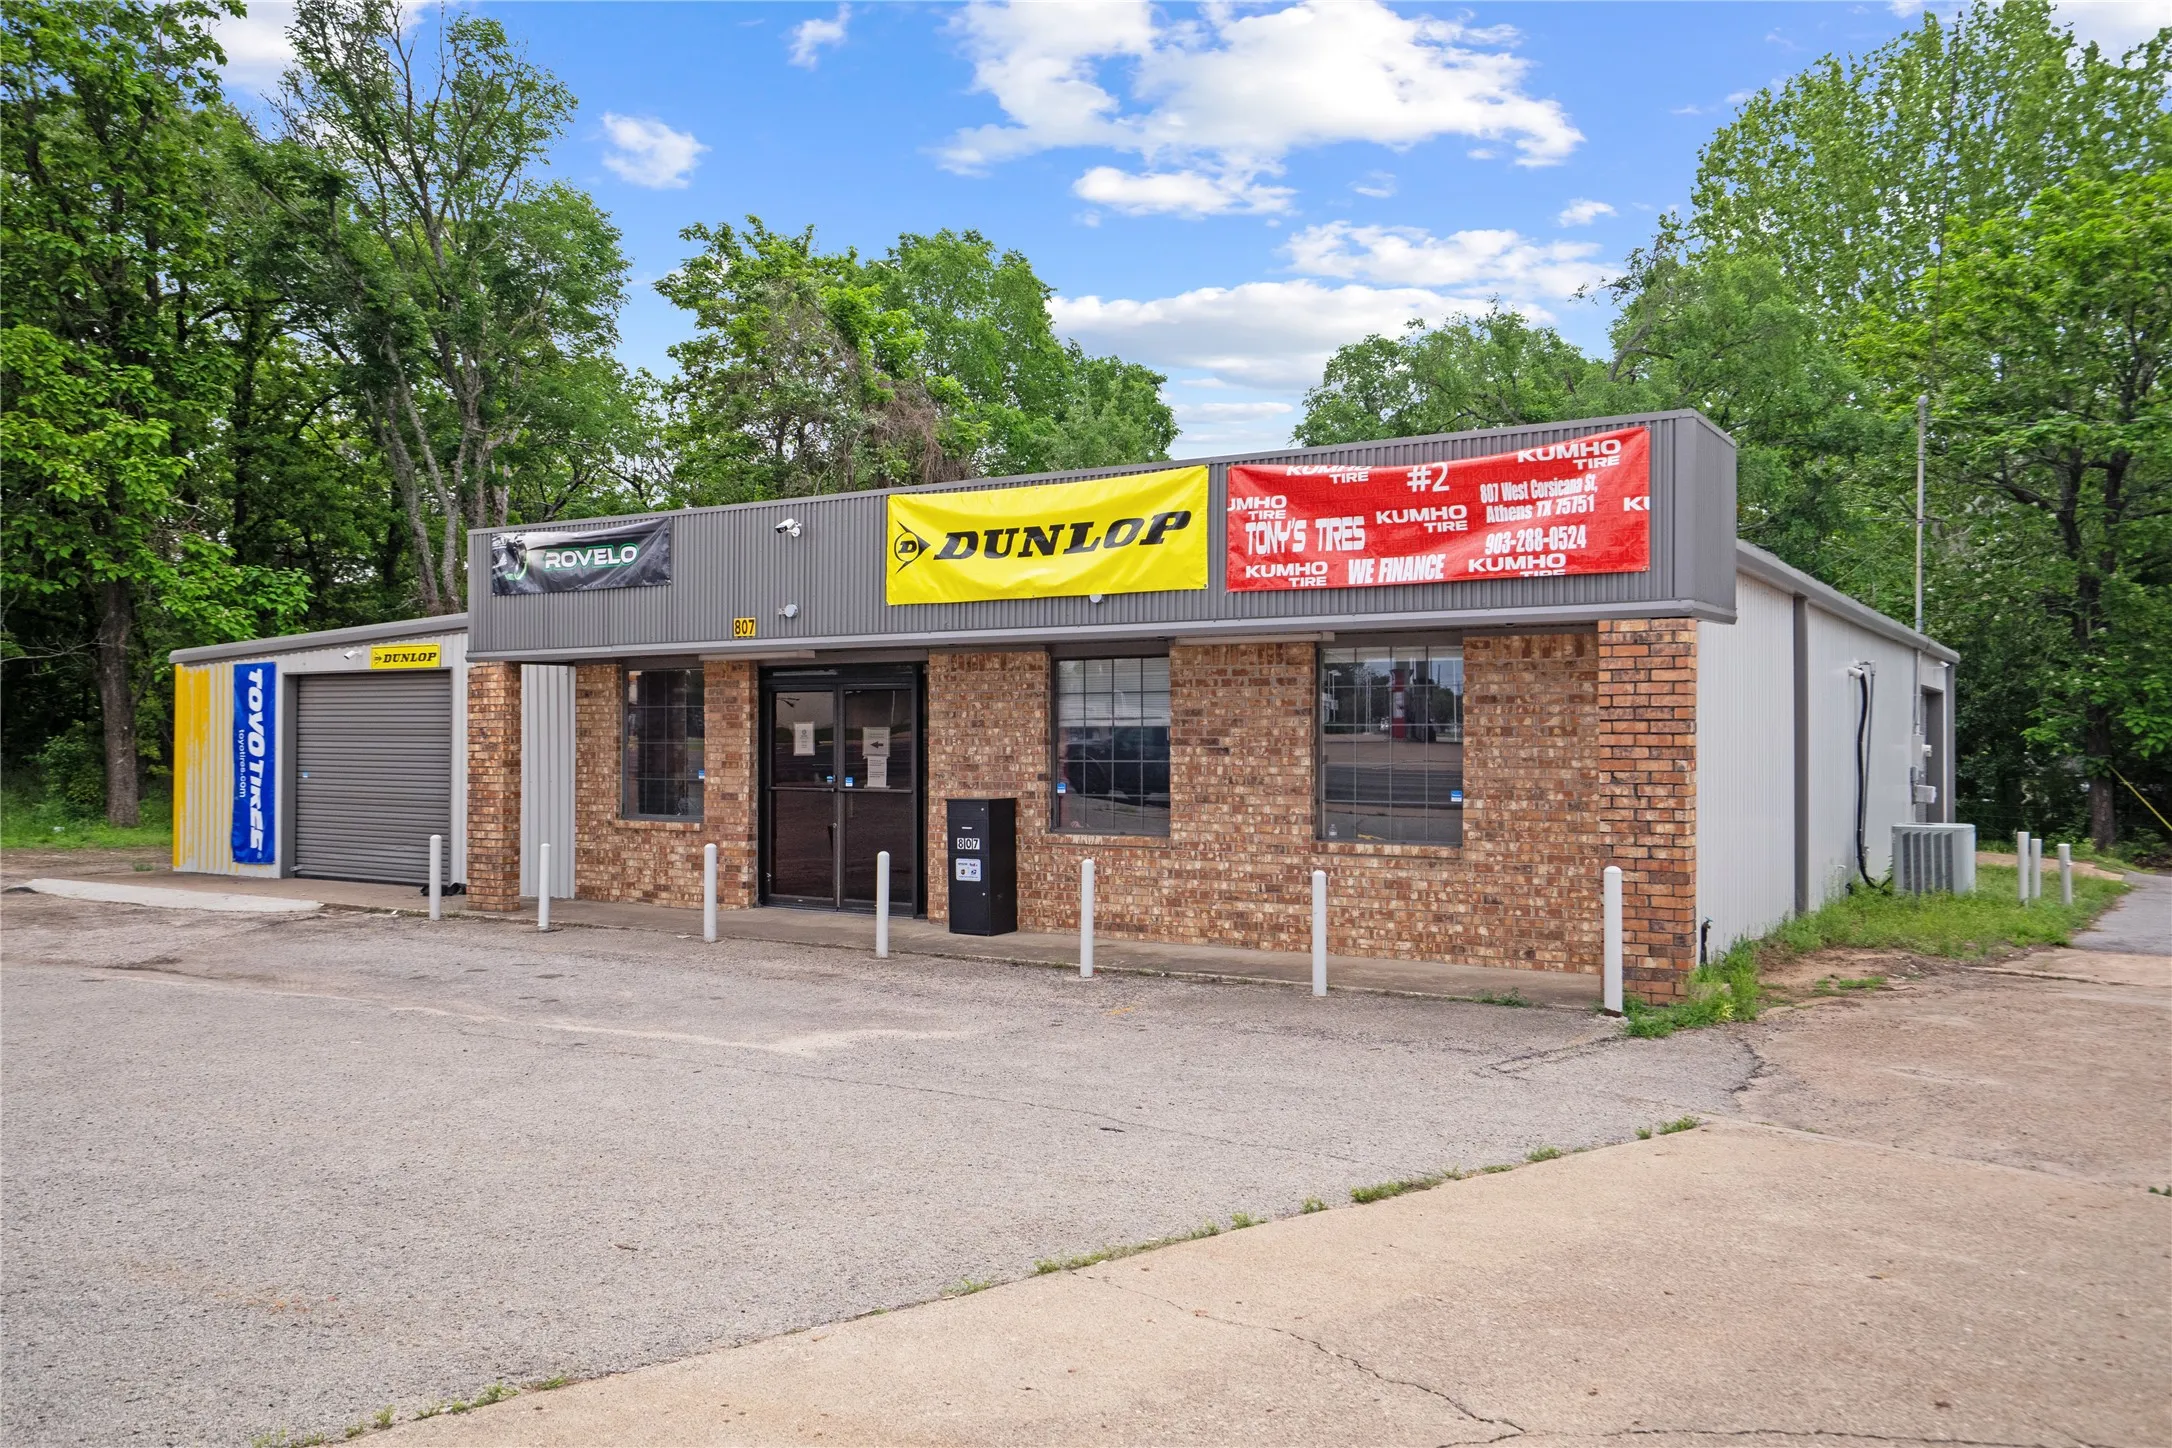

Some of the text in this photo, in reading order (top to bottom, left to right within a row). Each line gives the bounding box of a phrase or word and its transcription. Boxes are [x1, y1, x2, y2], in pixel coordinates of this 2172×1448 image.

[1518, 439, 1621, 463] KUMHO
[1573, 455, 1621, 470] TIRE
[1329, 471, 1369, 484] TIRE
[1407, 462, 1450, 492] #2
[1480, 483, 1498, 503] 807
[1501, 481, 1529, 502] West
[1530, 477, 1583, 499] Corsicana
[1248, 509, 1286, 520] TIRE
[1376, 505, 1468, 524] KUMHO
[1486, 494, 1595, 524] Athens TX 75751
[933, 510, 1192, 561] DUNLOP
[1245, 516, 1366, 555] TONY'S TIRES
[1424, 520, 1468, 533] TIRE
[1485, 525, 1587, 555] 903-288-0524
[545, 546, 638, 569] ROVELO
[1468, 553, 1566, 572] KUMHO
[1245, 561, 1328, 578] KUMHO
[1348, 553, 1446, 584] WE FINANCE
[1288, 576, 1327, 587] TIRE
[735, 619, 755, 635] 807
[383, 652, 437, 663] DUNLOP
[248, 668, 265, 757] TOYO
[958, 838, 979, 849] 807
